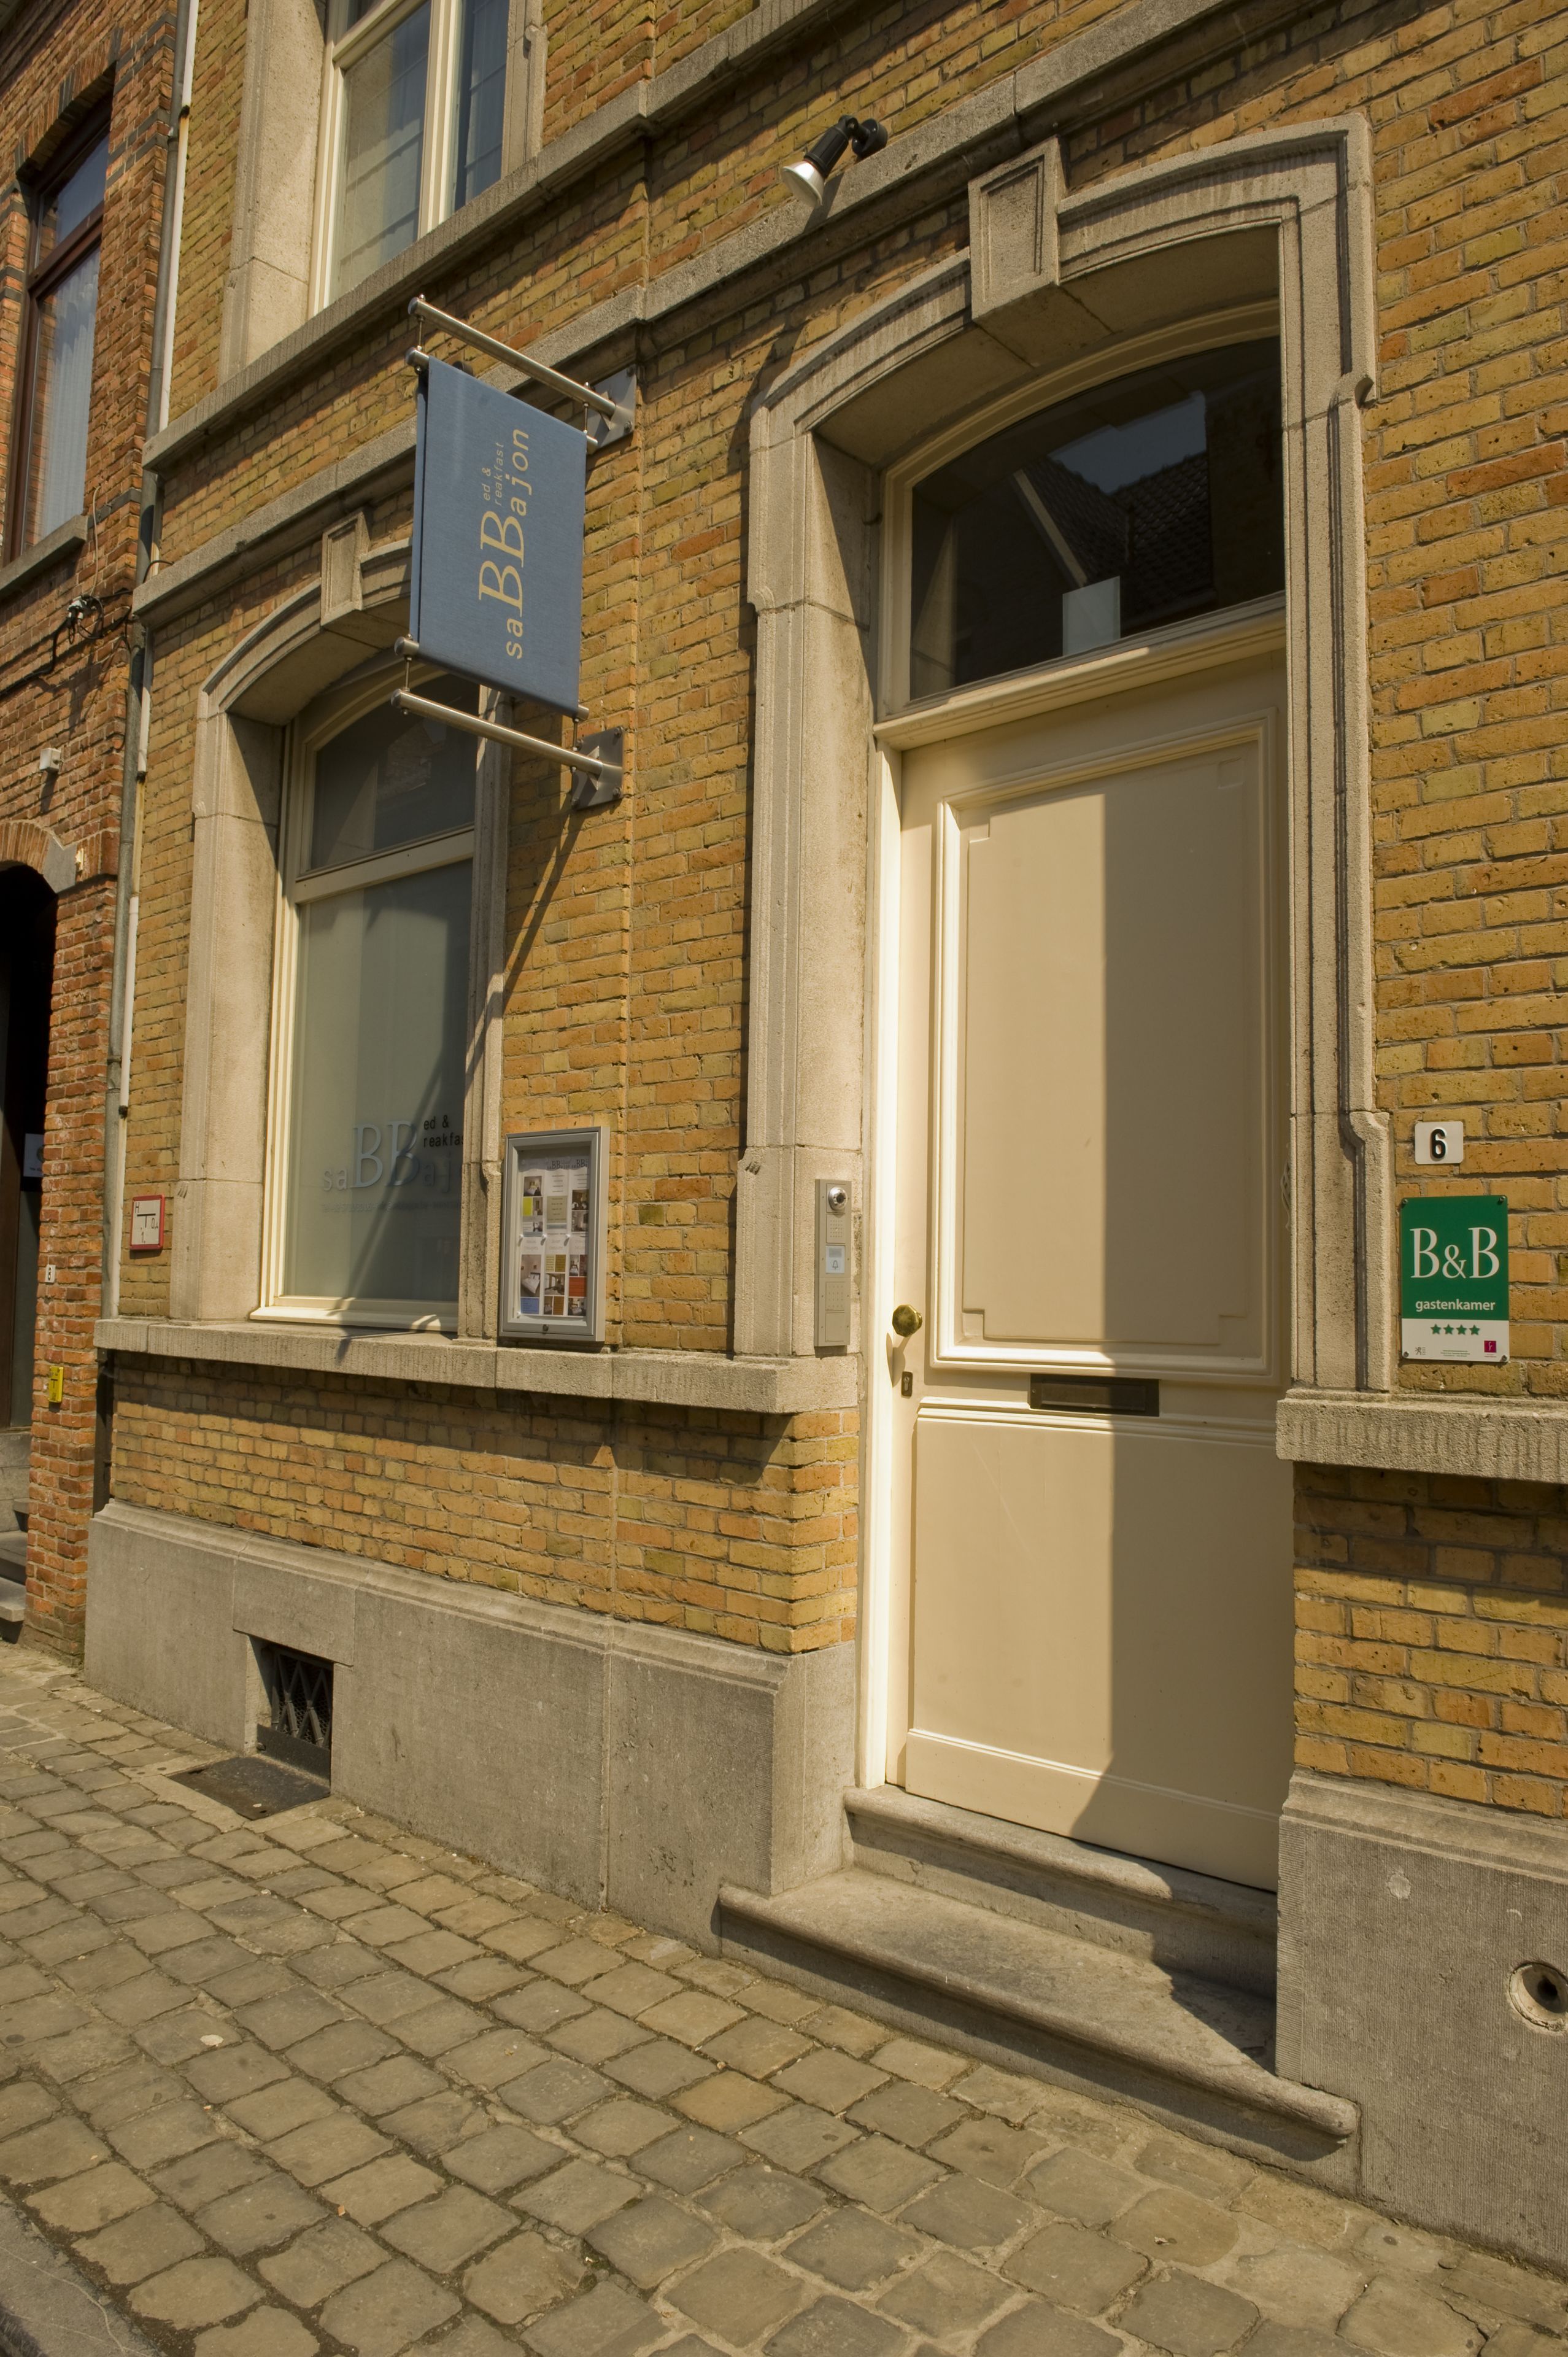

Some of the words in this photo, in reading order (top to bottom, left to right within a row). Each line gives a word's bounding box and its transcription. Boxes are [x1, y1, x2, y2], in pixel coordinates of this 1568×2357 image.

[482, 466, 492, 477] &
[493, 441, 504, 506] reakfast
[481, 482, 491, 501] ed
[423, 1116, 436, 1131] ed
[441, 1114, 450, 1129] &
[1429, 1128, 1447, 1159] 6
[1410, 1226, 1500, 1279] B&B
[1415, 1298, 1496, 1312] gastenkamer
